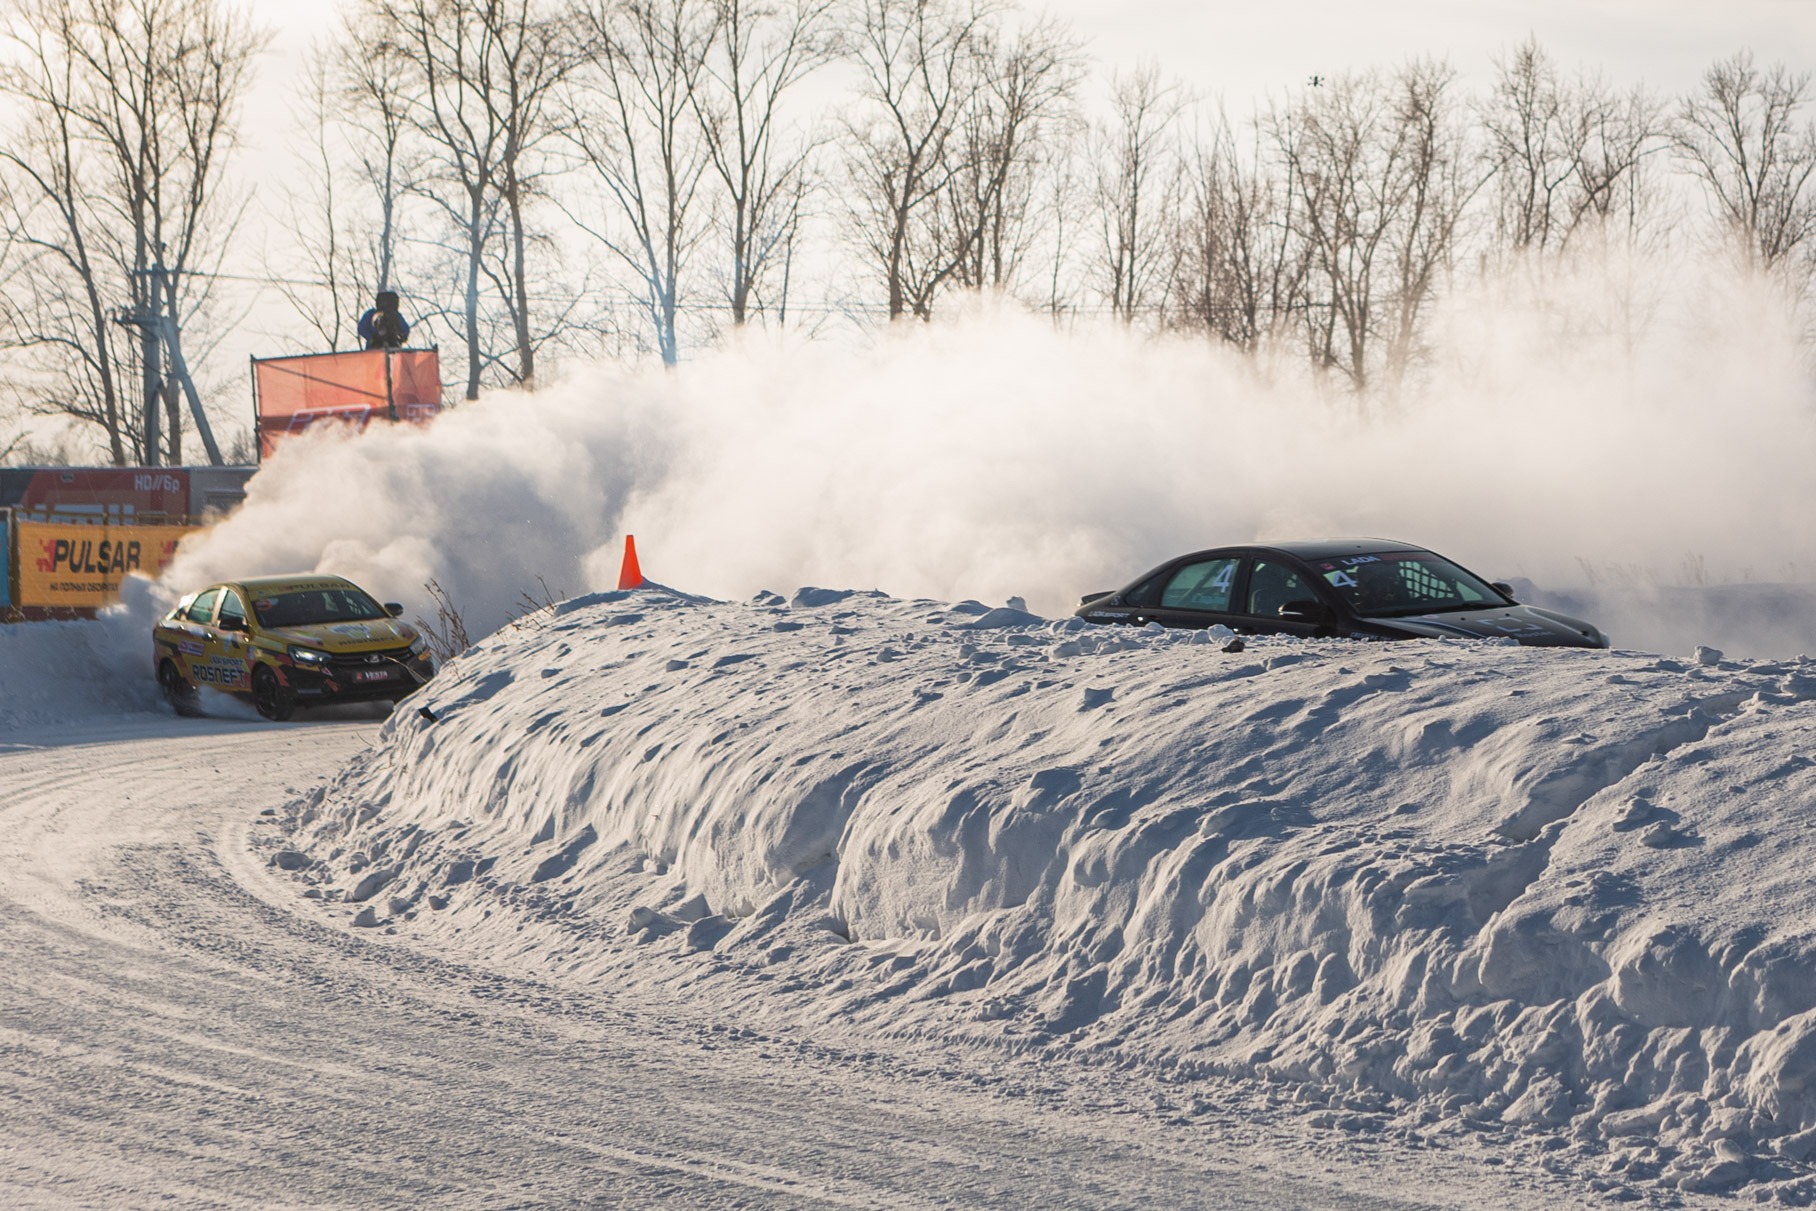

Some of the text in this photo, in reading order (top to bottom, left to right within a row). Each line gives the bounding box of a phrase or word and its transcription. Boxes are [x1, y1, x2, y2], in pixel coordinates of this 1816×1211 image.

[53, 539, 141, 574] PULSAR
[1341, 556, 1381, 565] LADA
[1212, 564, 1234, 593] 4
[1333, 570, 1359, 588] 4
[192, 664, 245, 687] ROSNEFT
